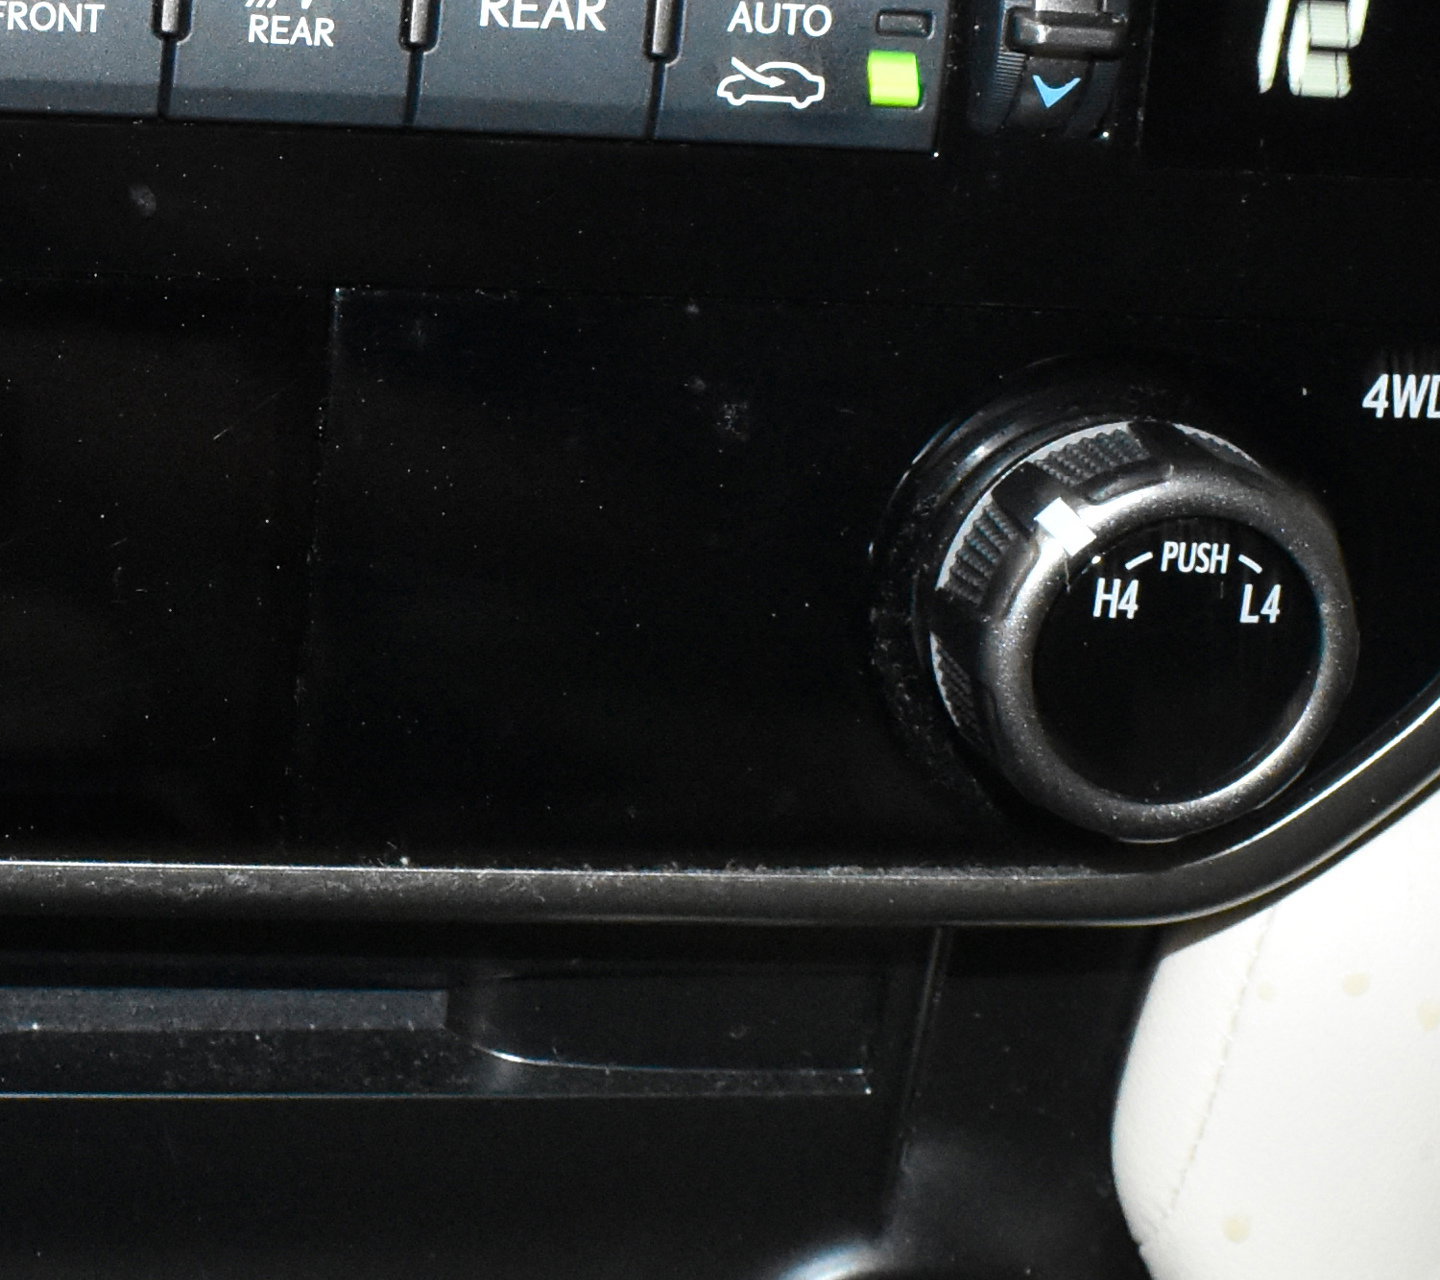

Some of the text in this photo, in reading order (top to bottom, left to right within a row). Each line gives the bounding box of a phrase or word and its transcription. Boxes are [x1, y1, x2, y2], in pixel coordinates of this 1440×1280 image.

[247, 13, 335, 48] REAR
[727, 1, 832, 36] AUTO
[1161, 541, 1230, 574] PUSH
[1093, 577, 1138, 619] H4
[1240, 584, 1281, 623] L4
